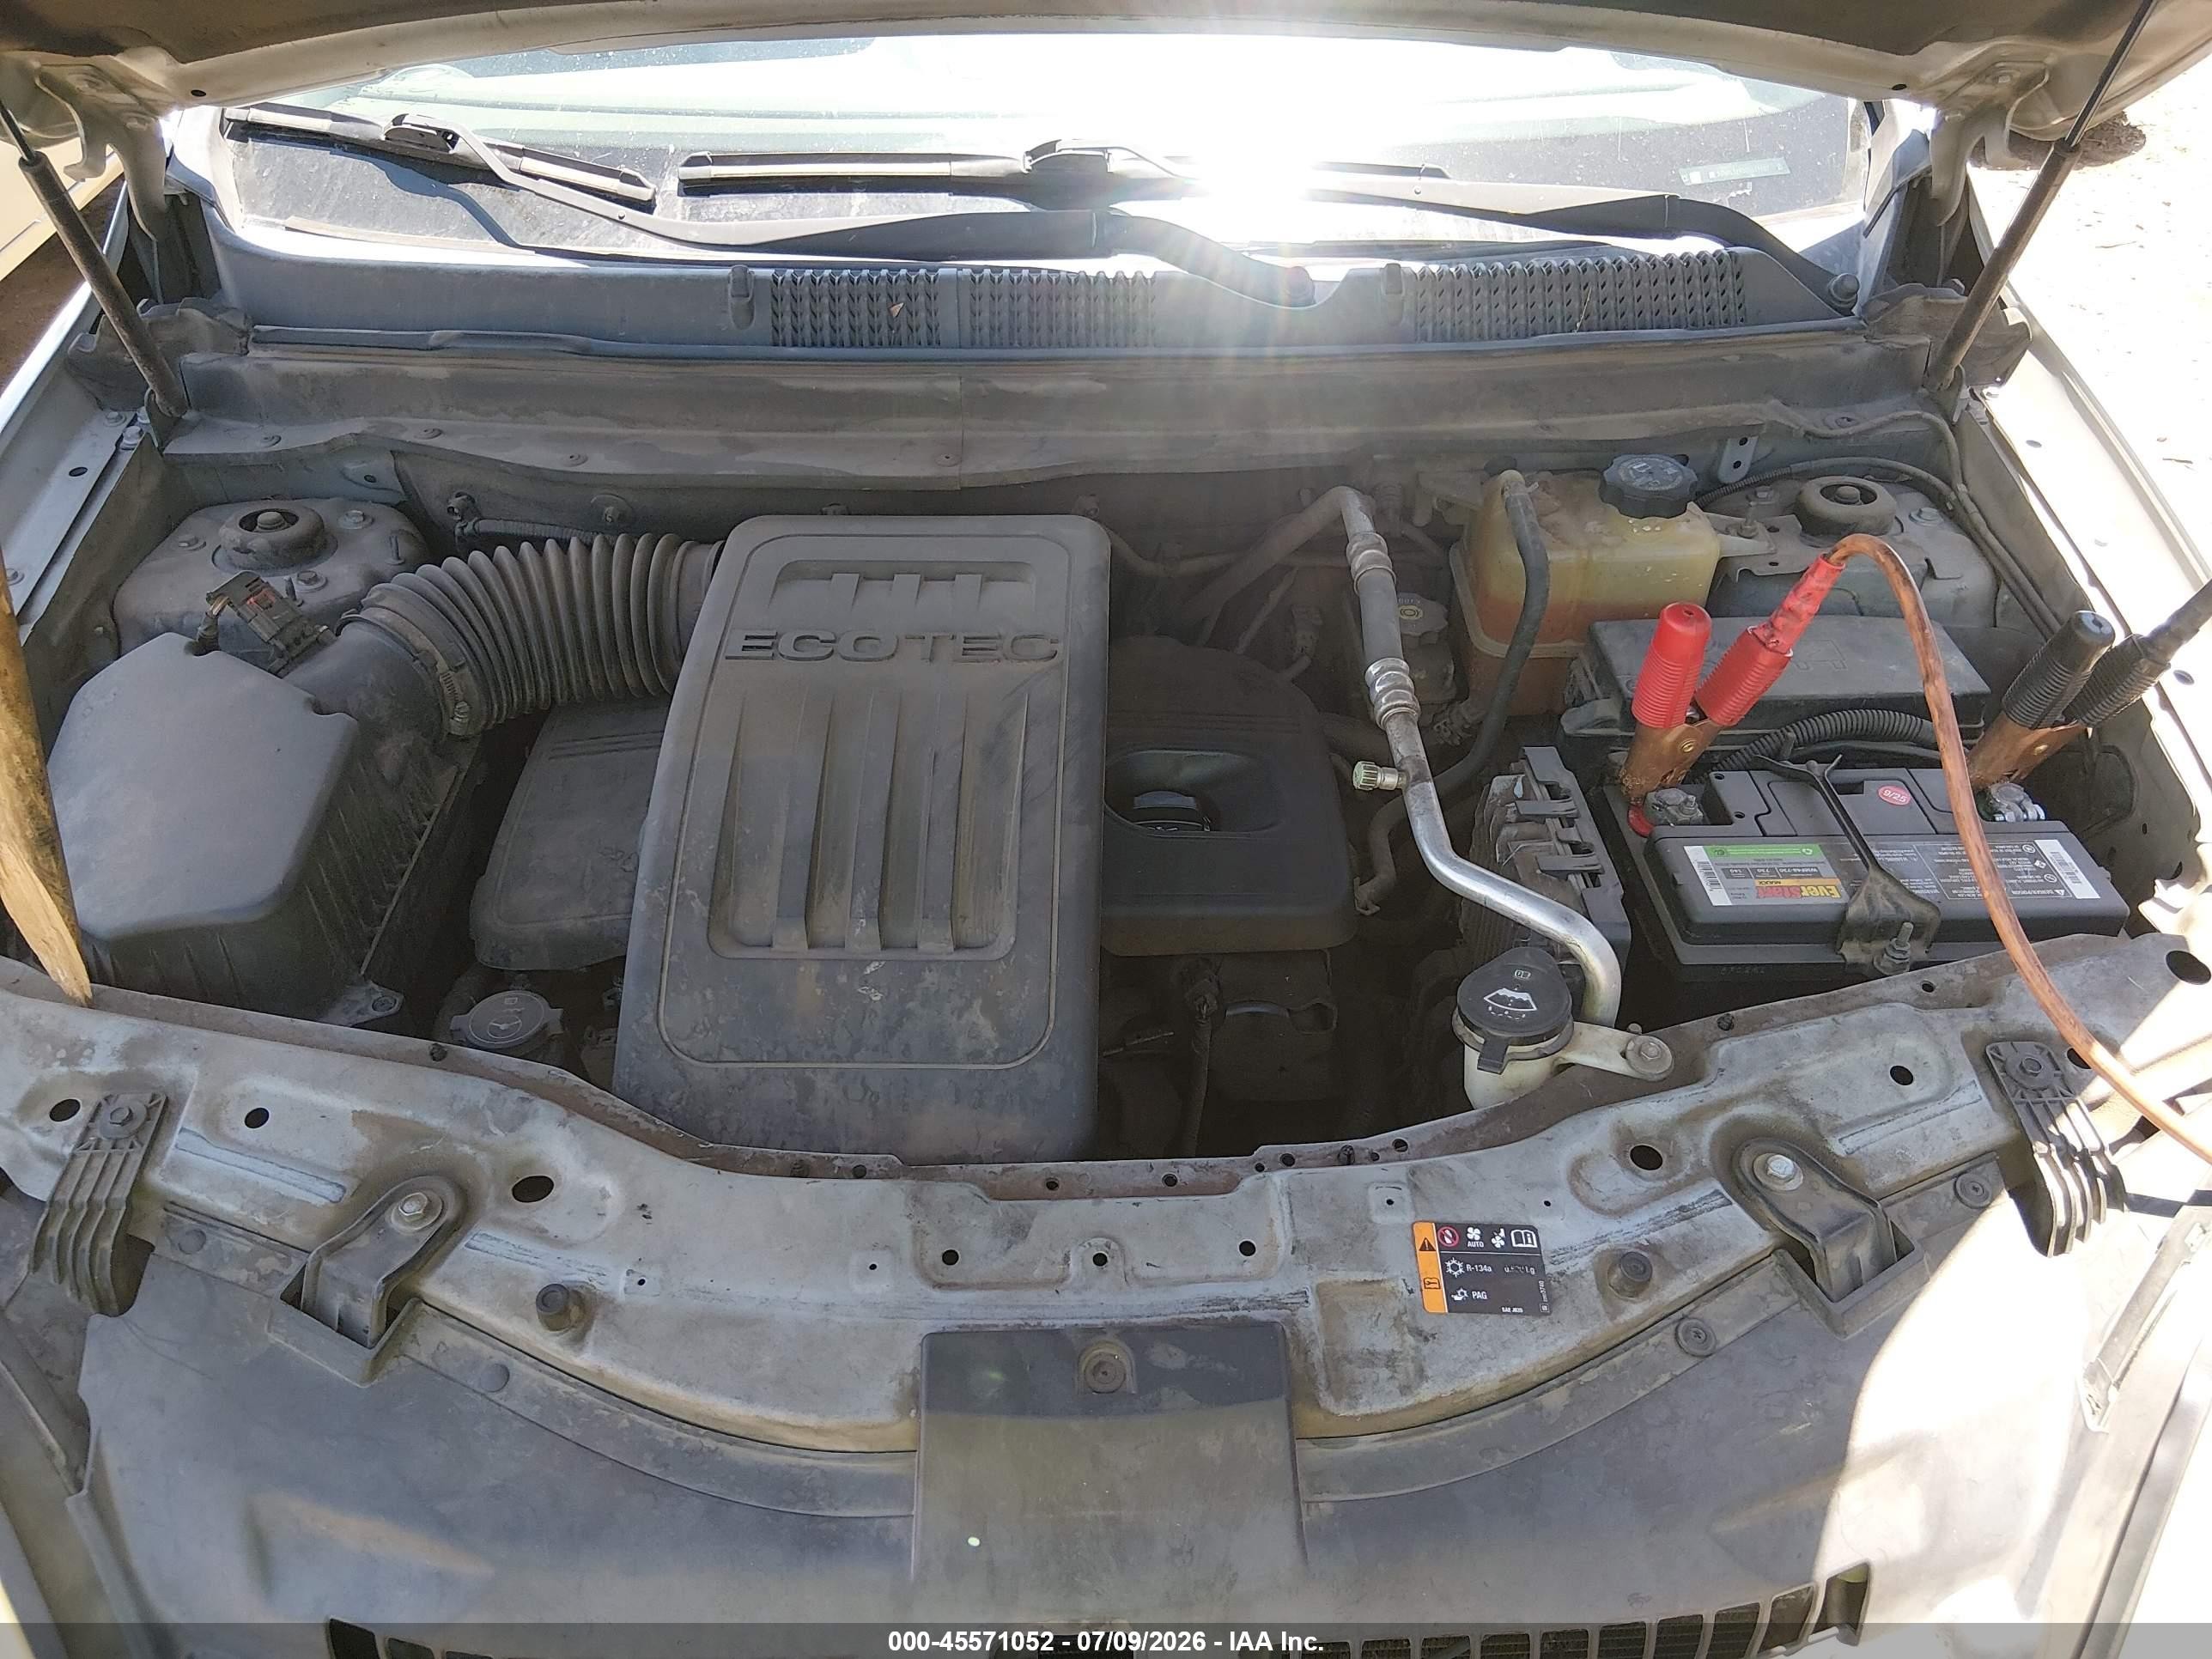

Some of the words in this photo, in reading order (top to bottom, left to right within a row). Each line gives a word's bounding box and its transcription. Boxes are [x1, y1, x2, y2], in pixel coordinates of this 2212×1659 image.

[725, 629, 1060, 663] ECOTEC
[1882, 788, 1908, 803] 9/25
[1755, 885, 1841, 899] EverStart
[1466, 1264, 1492, 1273] R-134a
[1472, 1291, 1488, 1300] PAG
